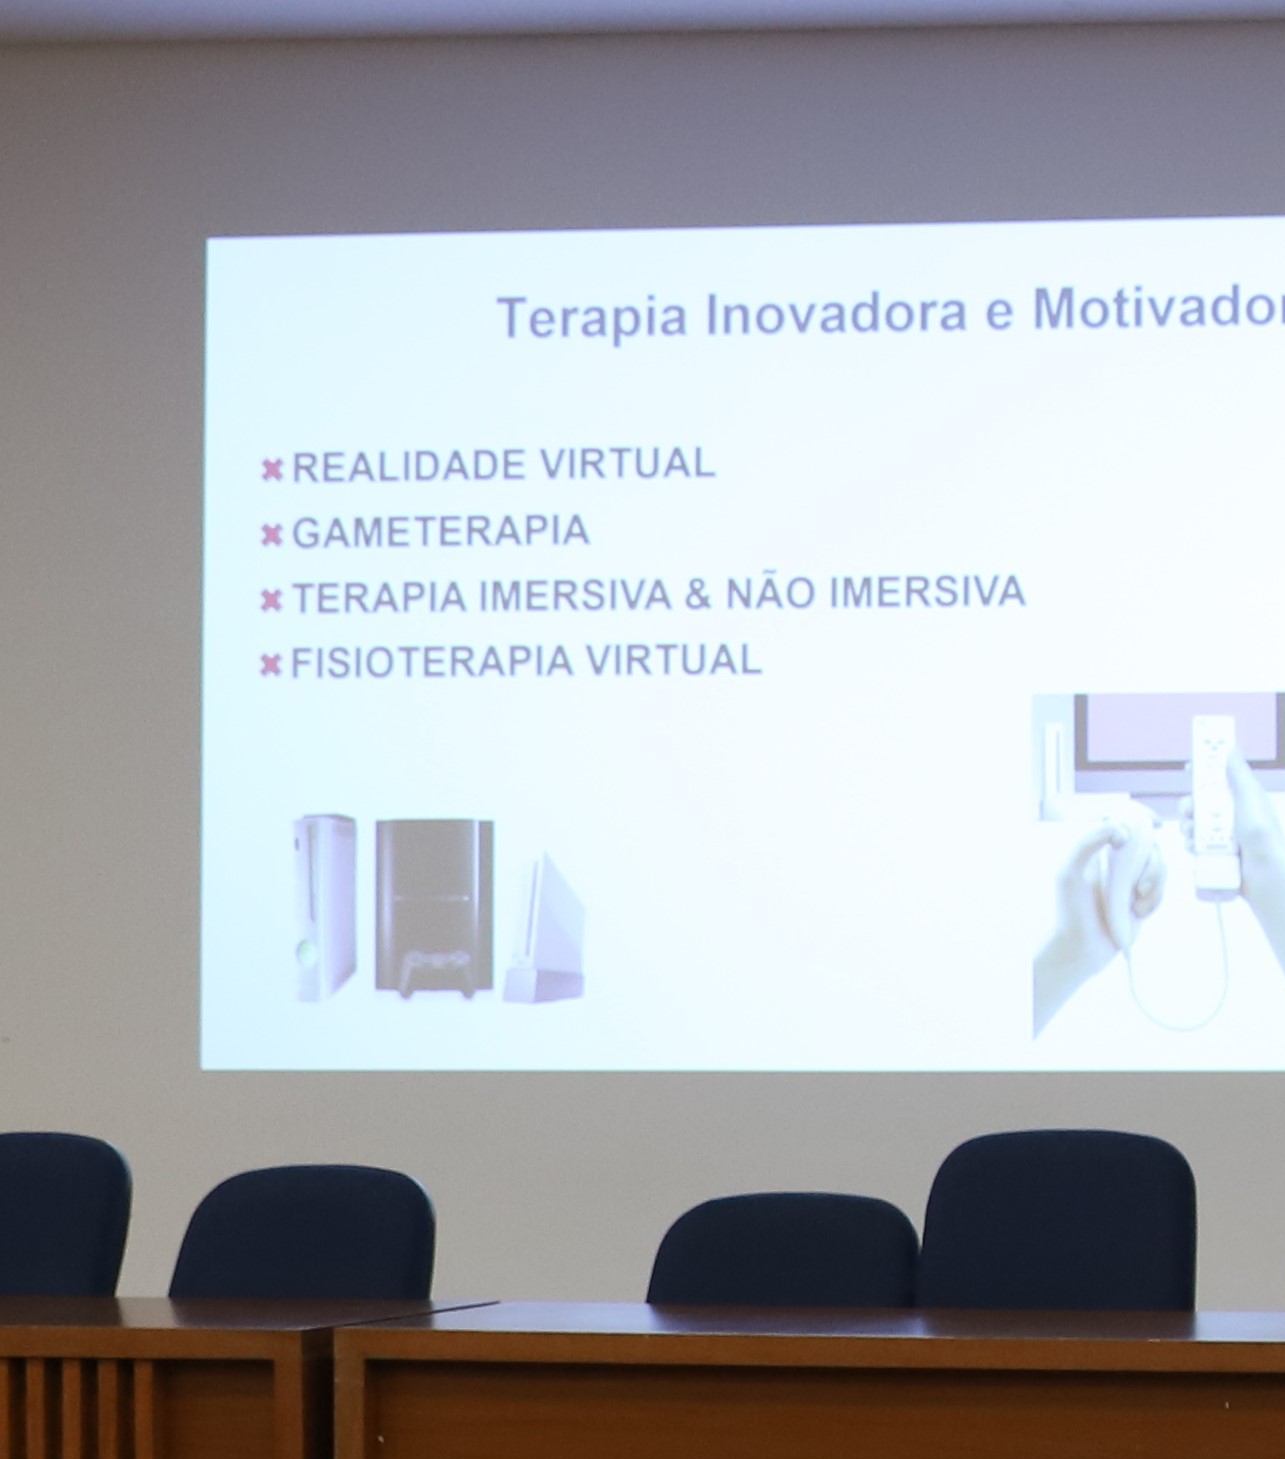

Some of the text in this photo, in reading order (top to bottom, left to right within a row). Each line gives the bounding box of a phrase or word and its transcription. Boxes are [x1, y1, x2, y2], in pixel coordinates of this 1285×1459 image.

[496, 294, 687, 348] Terapia
[707, 290, 967, 335] Inovadora
[985, 297, 1014, 331] e
[292, 446, 716, 483] REALIDADE VIRTUAL
[292, 513, 591, 549] GAMETERAPIA
[292, 568, 1027, 613] TERAPIA IMERSIVA & NÃO IMERSIVA
[292, 642, 763, 679] FISIOTERAPIA VIRTUAL
